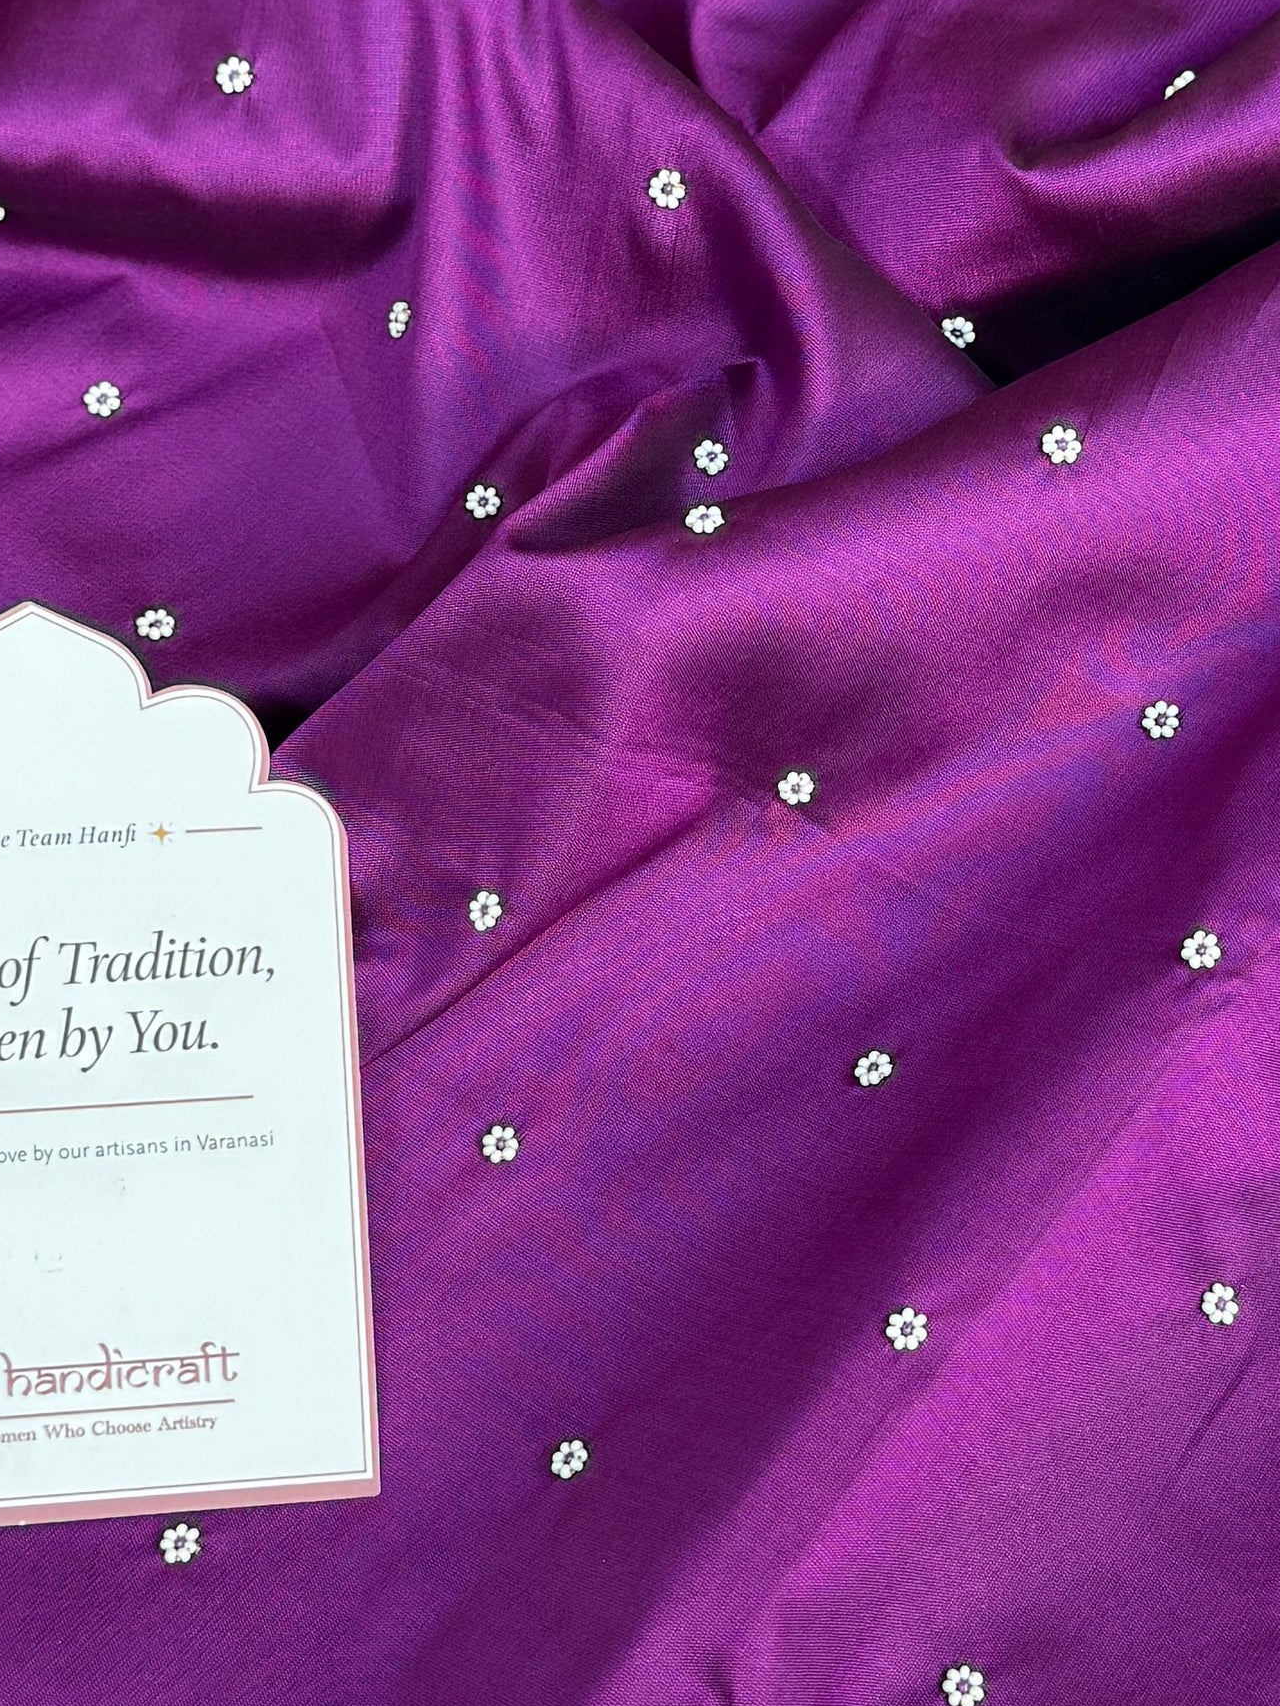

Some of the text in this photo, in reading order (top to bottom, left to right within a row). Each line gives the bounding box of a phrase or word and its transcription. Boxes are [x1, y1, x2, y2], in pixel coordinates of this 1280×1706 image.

[17, 829, 71, 847] Team
[79, 823, 136, 848] Hanfi
[58, 930, 274, 985] Tradition,
[59, 1007, 113, 1073] by
[126, 1010, 218, 1053] You.
[34, 1145, 53, 1165] by
[59, 1146, 90, 1159] our
[96, 1141, 168, 1157] artisans
[175, 1137, 190, 1151] in
[197, 1131, 273, 1150] Varanasi
[43, 1424, 85, 1439] Who
[92, 1421, 151, 1436] Choose
[158, 1416, 217, 1431] Artistry
